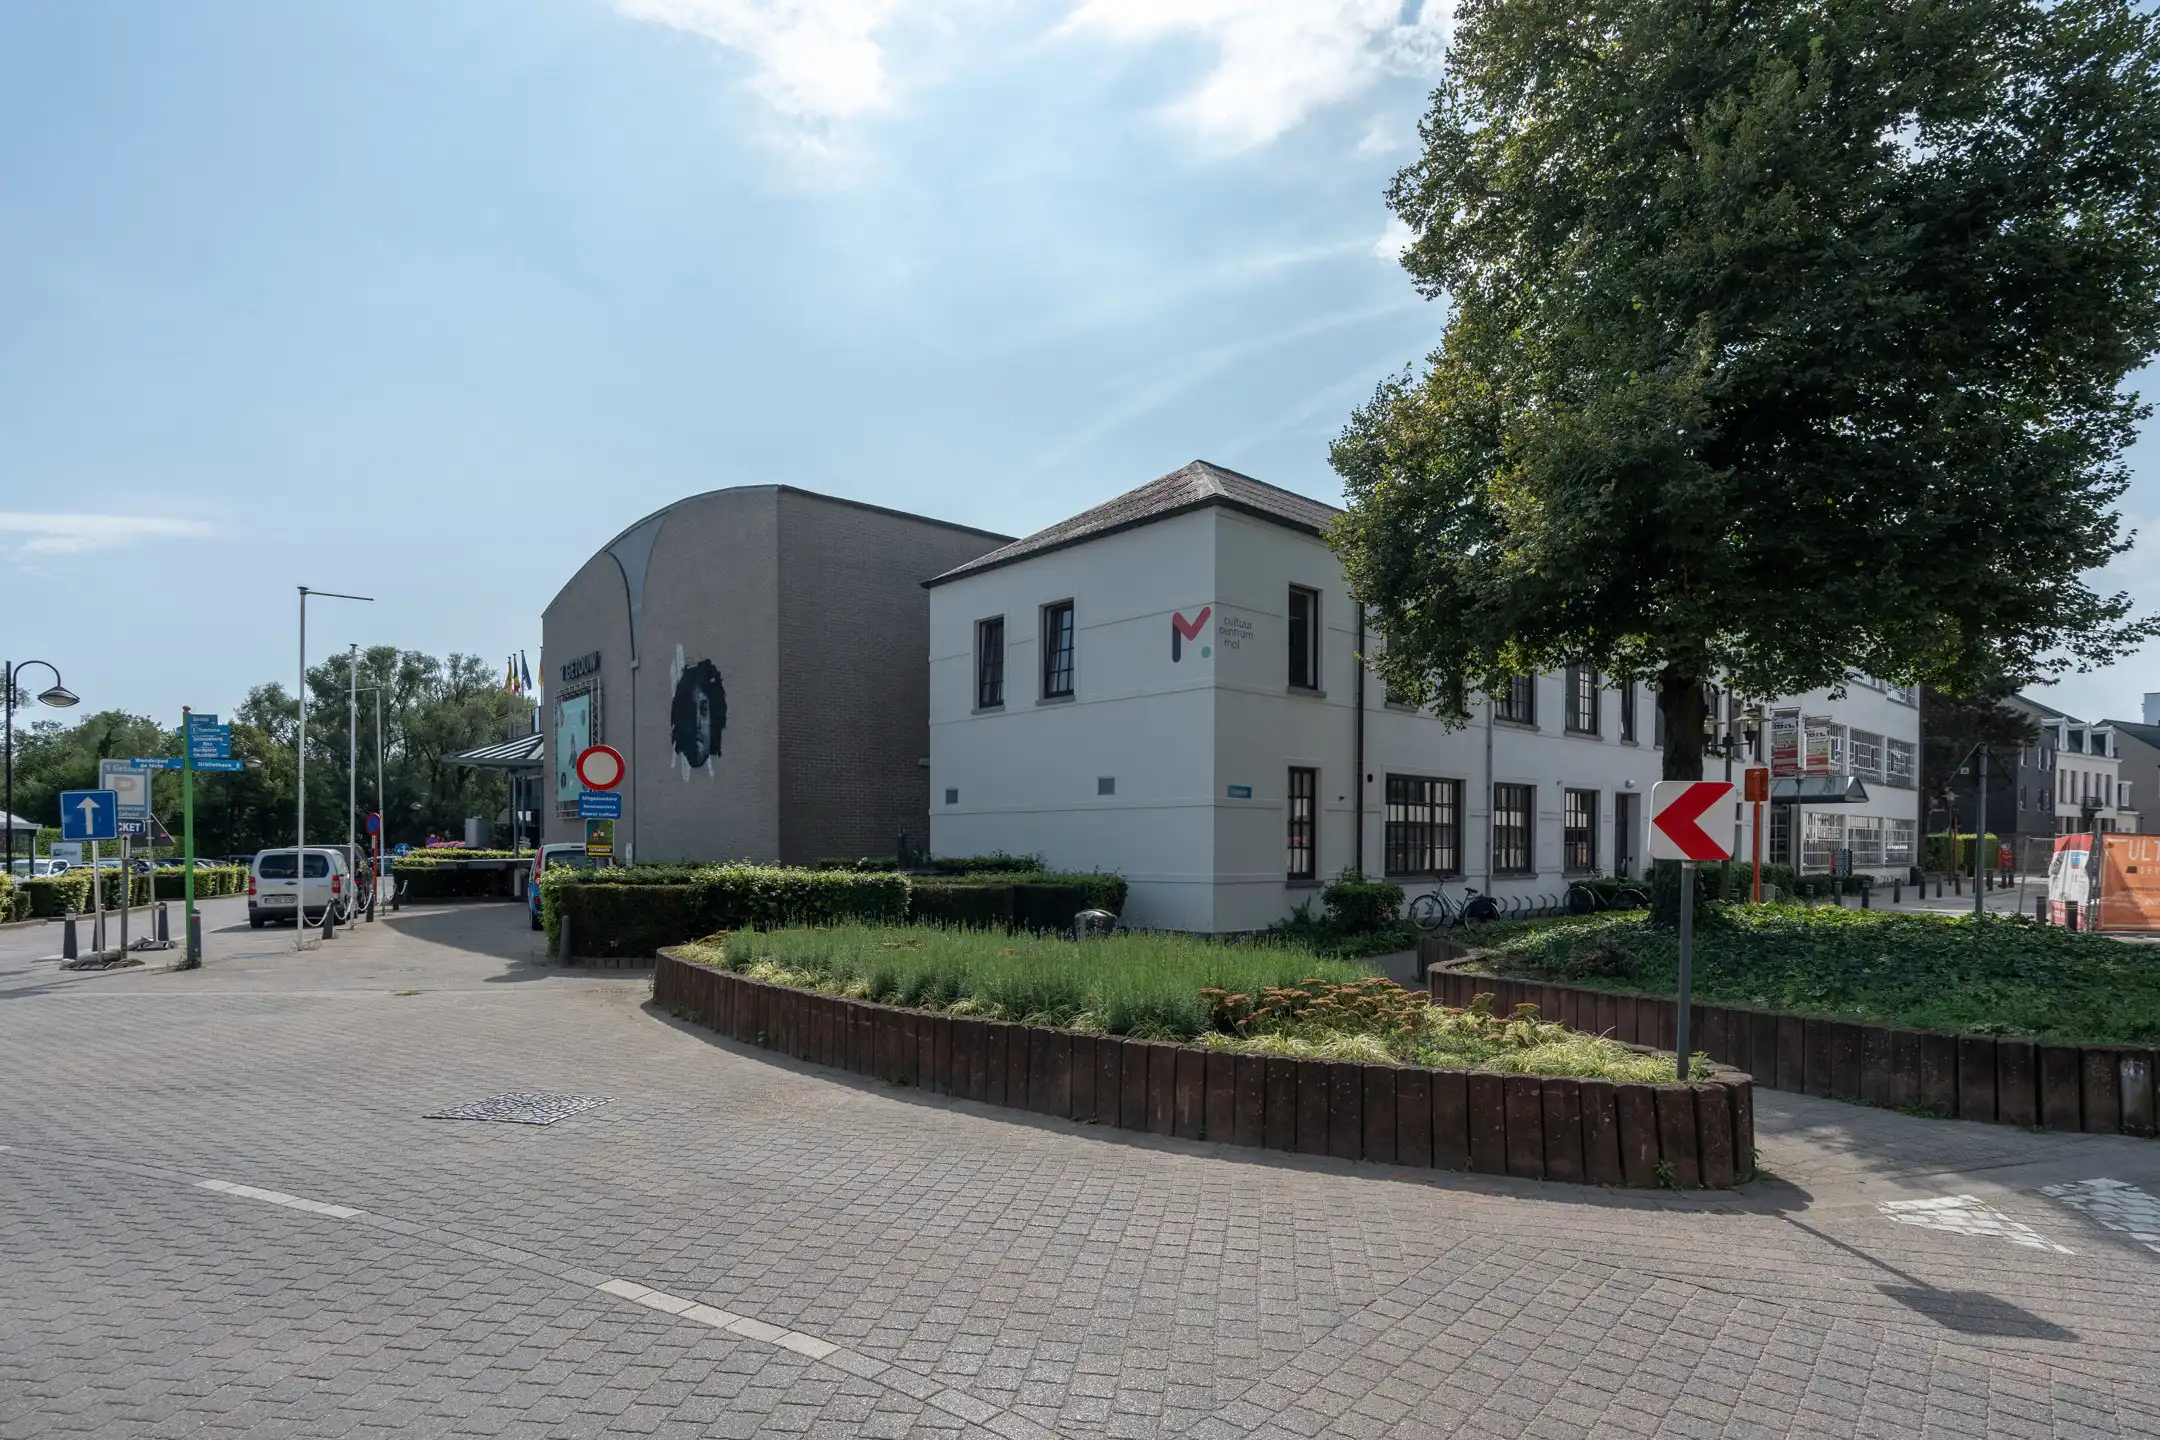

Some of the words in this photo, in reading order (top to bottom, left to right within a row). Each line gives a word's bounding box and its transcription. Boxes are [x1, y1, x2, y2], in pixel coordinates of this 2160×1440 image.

[1224, 617, 1252, 629] cultuur
[1219, 626, 1253, 640] centrum
[1224, 639, 1240, 650] mol
